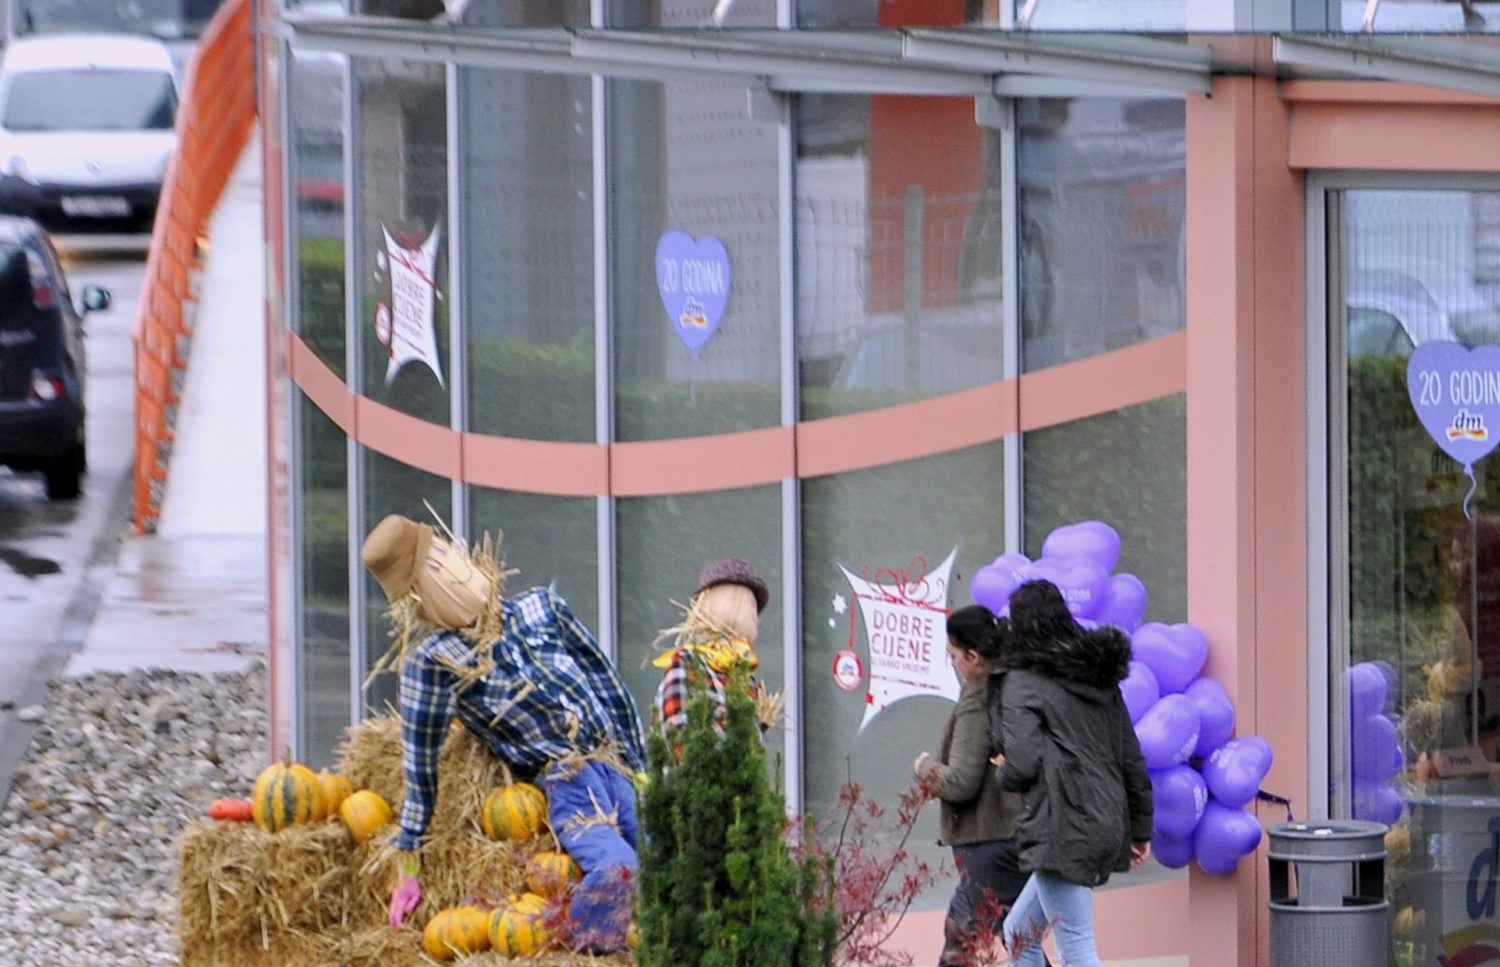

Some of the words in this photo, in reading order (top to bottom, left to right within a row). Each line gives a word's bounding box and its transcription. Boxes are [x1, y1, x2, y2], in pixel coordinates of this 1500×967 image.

[663, 257, 677, 292] 20
[1418, 369, 1441, 406] 20
[1454, 408, 1484, 430] dm
[873, 609, 934, 639] DOBRE
[871, 633, 932, 663] CIJENE
